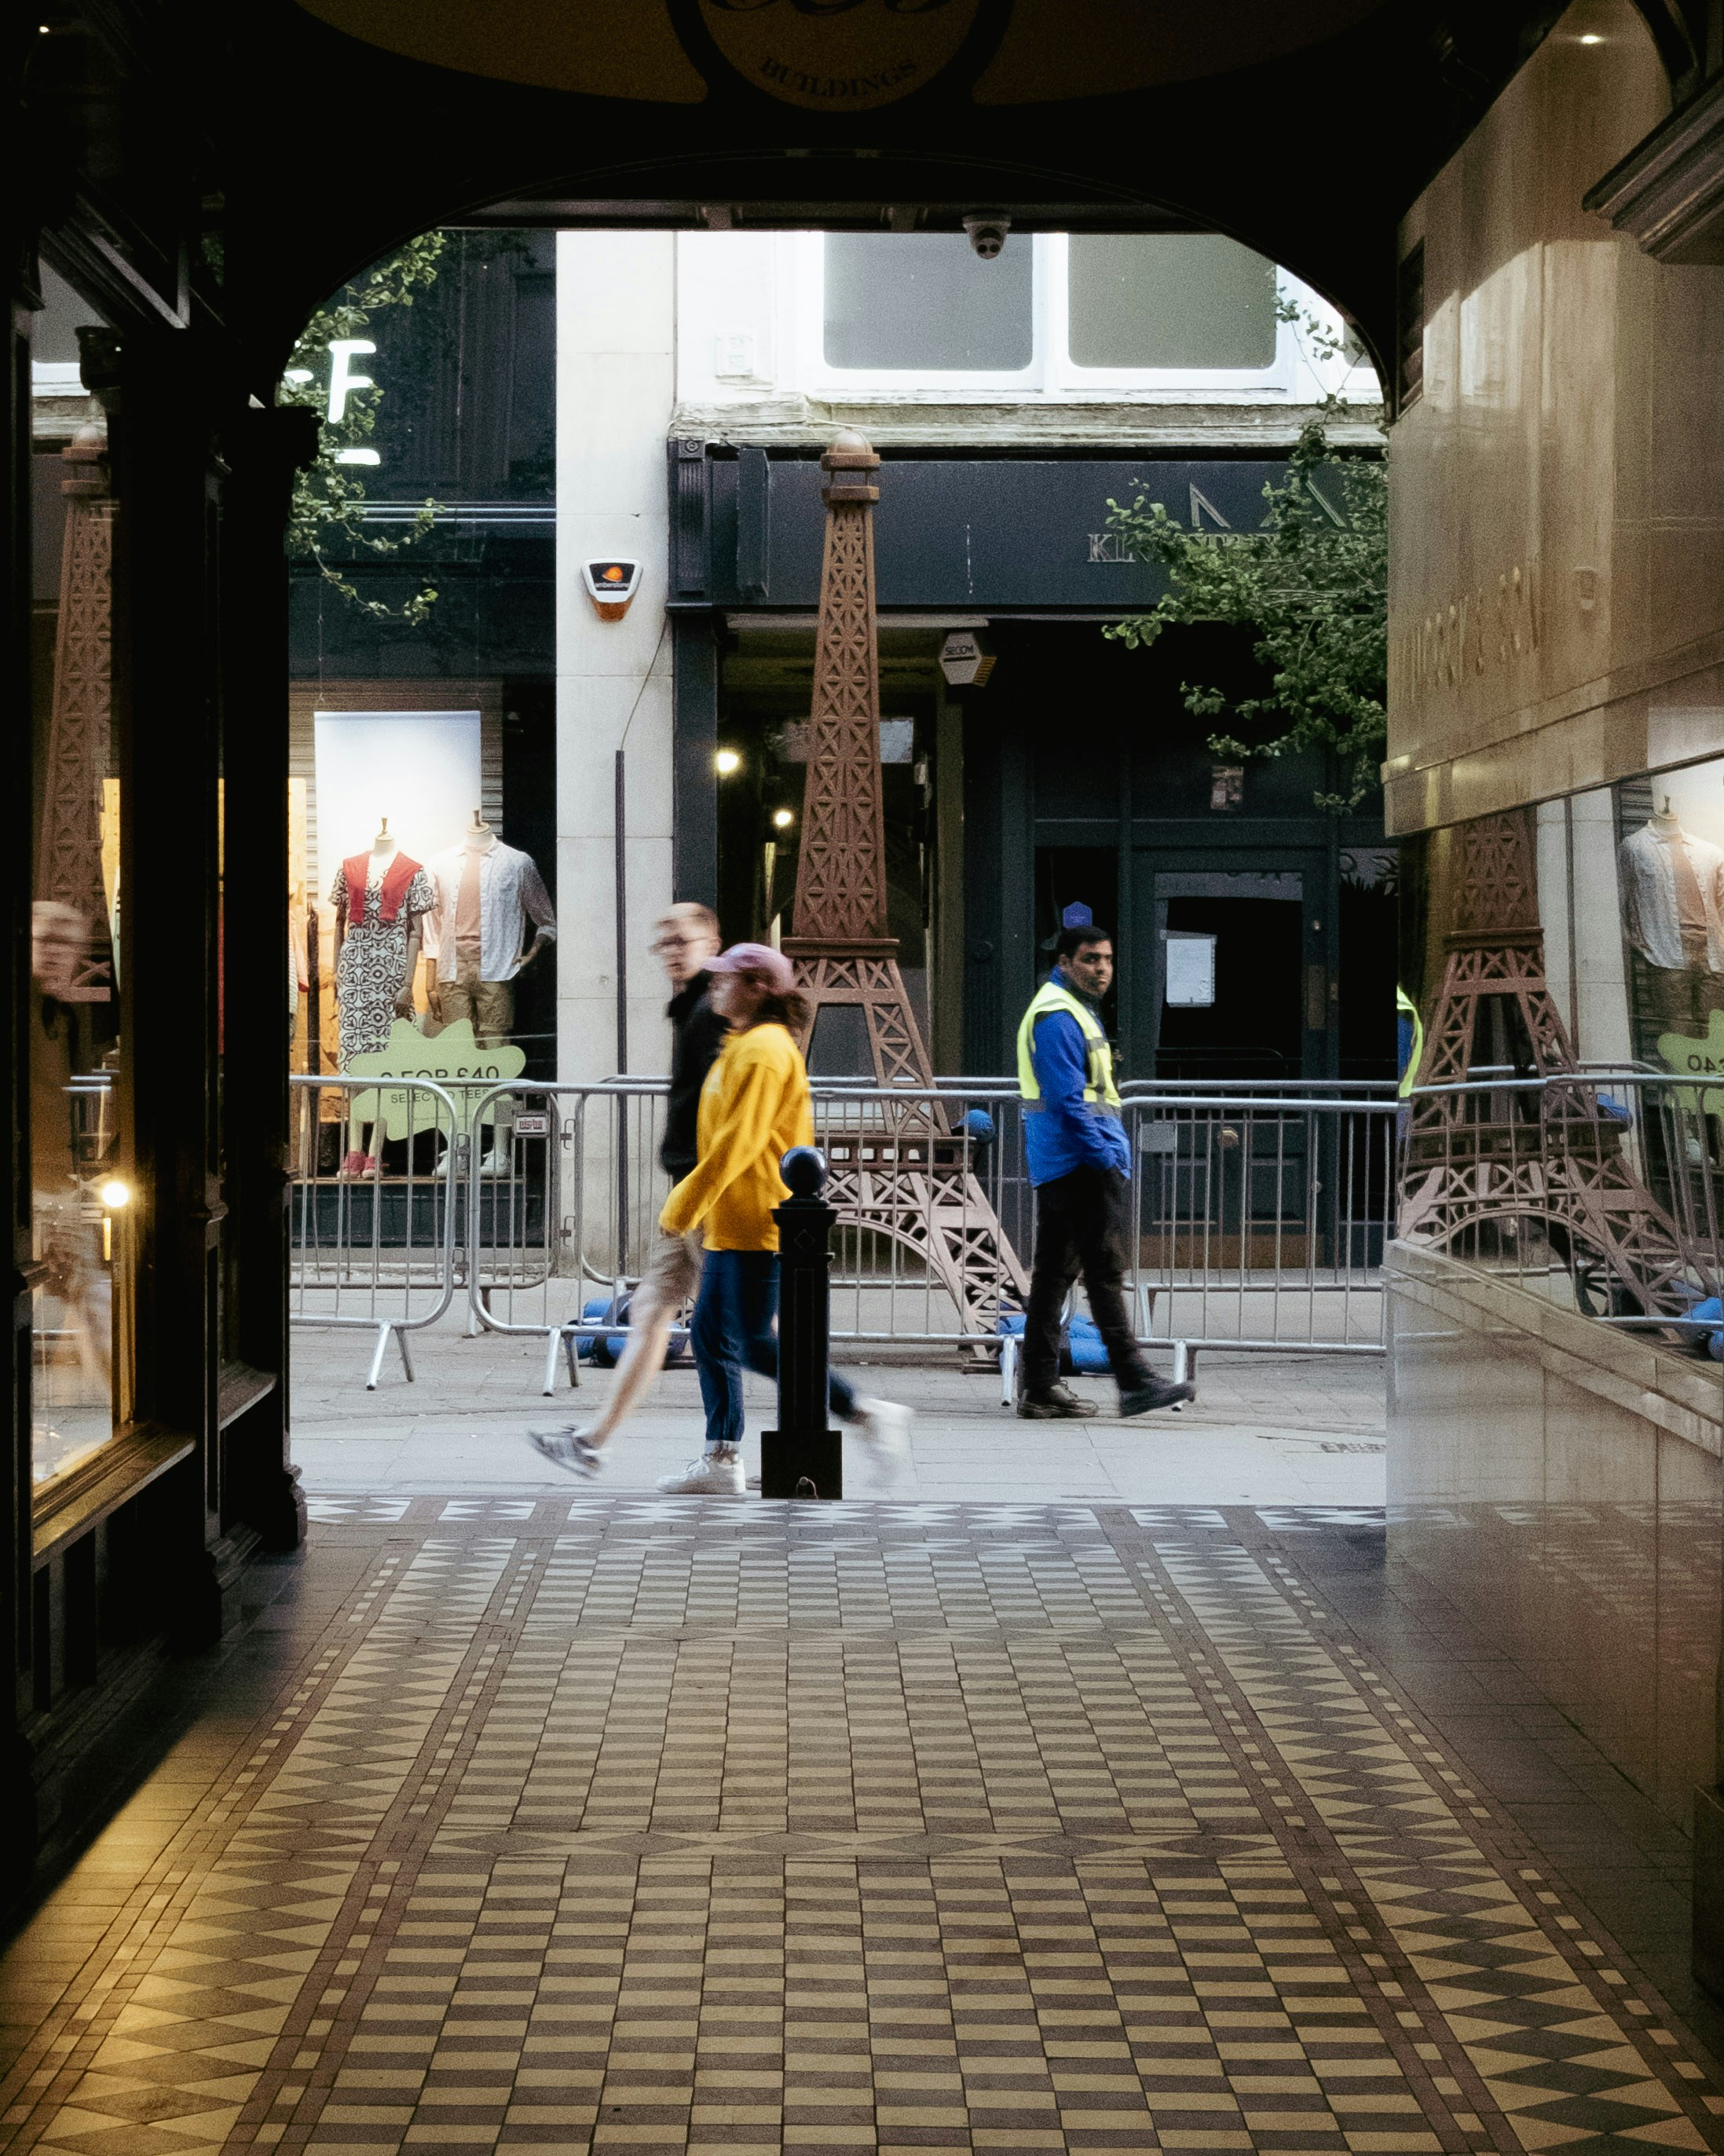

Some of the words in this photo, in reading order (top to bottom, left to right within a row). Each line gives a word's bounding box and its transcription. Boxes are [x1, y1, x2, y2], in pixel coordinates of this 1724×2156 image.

[760, 57, 917, 97] BUILDINGS
[945, 645, 974, 656] SECOM
[458, 1066, 500, 1078] £40
